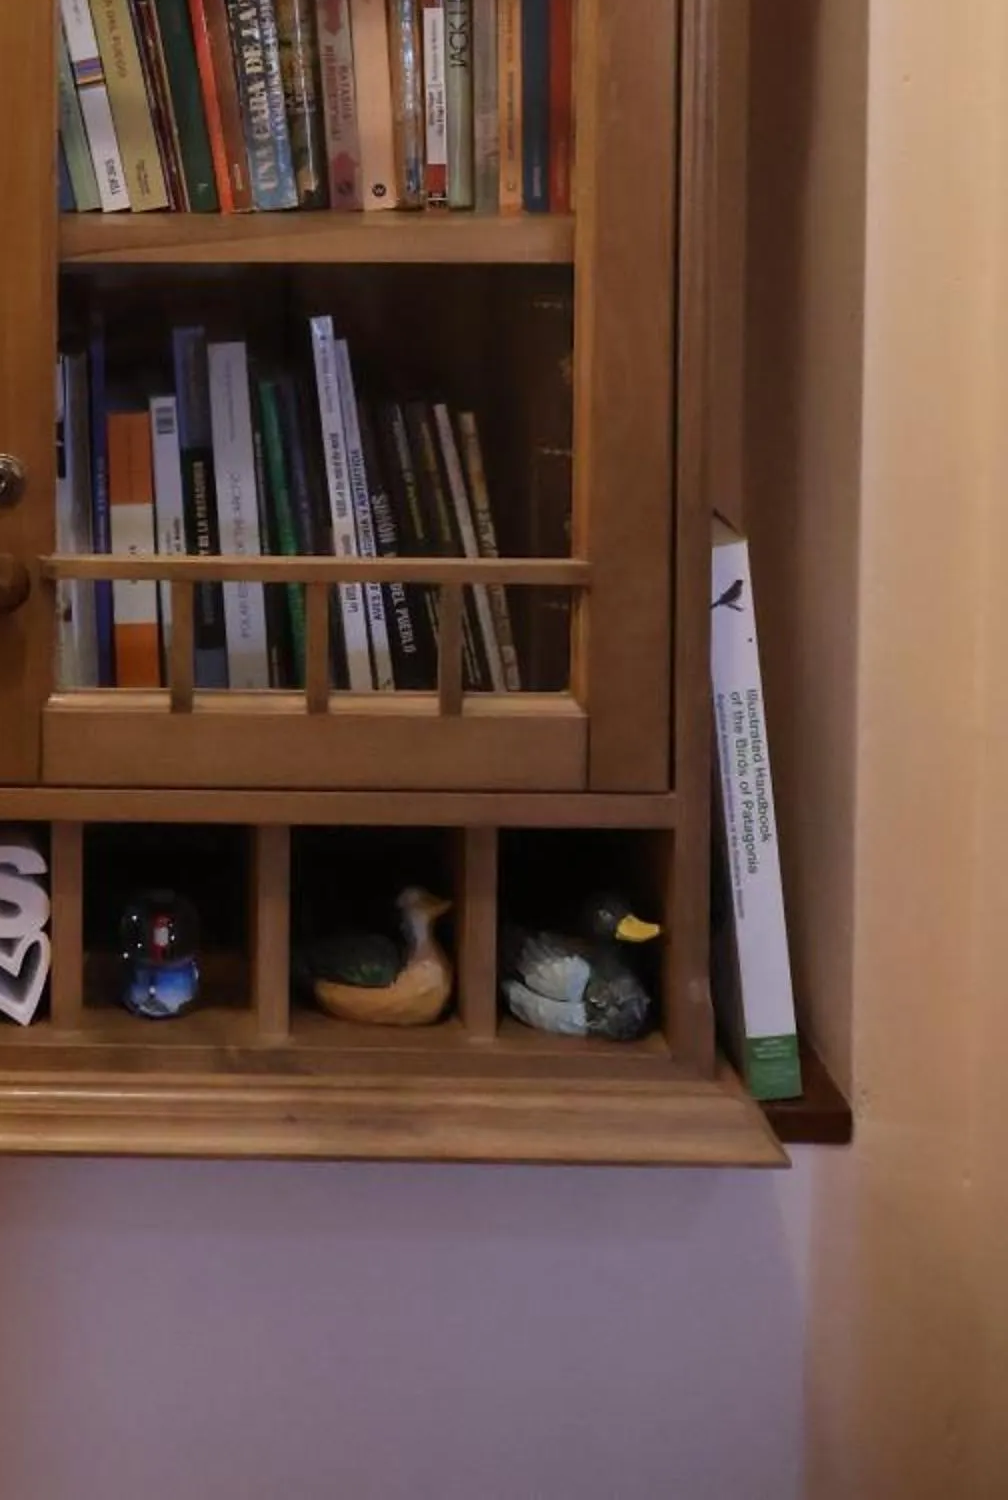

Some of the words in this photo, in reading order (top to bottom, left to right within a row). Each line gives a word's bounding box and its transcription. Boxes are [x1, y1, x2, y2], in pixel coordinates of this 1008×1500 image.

[449, 19, 469, 68] JACK
[730, 691, 741, 706] of
[734, 710, 745, 734] the
[736, 737, 749, 777] Birds
[747, 688, 762, 763] Illustrated
[755, 766, 770, 842] Handbook
[739, 780, 752, 798] of
[742, 800, 758, 875] Patagonia
